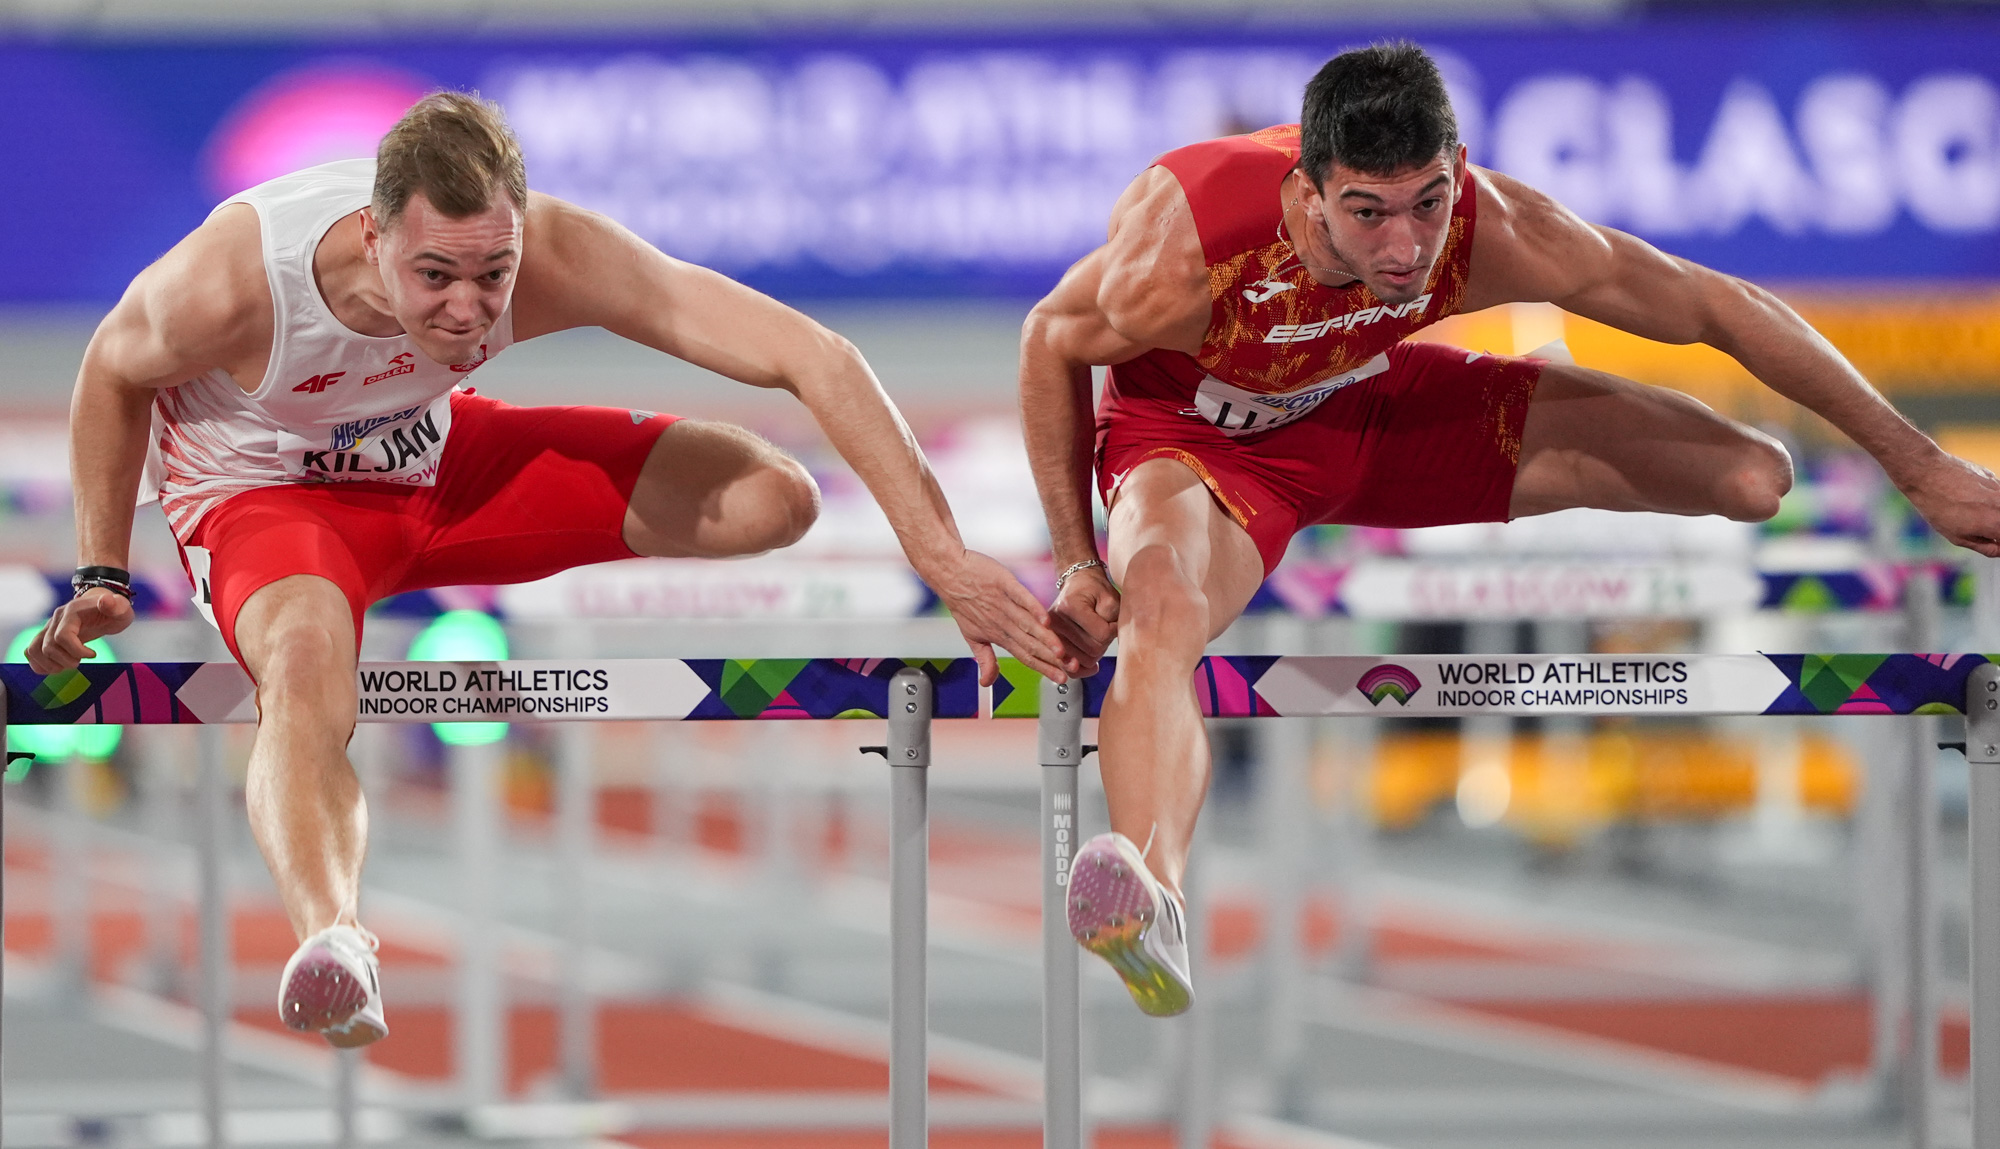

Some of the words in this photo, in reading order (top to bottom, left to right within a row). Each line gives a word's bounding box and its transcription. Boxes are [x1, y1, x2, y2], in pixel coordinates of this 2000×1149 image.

[291, 371, 347, 394] 4F
[366, 365, 412, 384] ORLEN
[302, 410, 441, 473] KILJAN
[360, 671, 457, 692] WORLD
[464, 670, 609, 692] ATHLETICS
[1438, 663, 1535, 685] WORLD
[1543, 662, 1688, 684] ATHLETICS
[359, 698, 438, 714] INDOOR
[443, 696, 609, 714] CHAMPIONSHIPS
[1437, 690, 1515, 706] INDOOR
[1521, 689, 1688, 706] CHAMPIONSHIPS
[1053, 814, 1071, 886] MONDO
